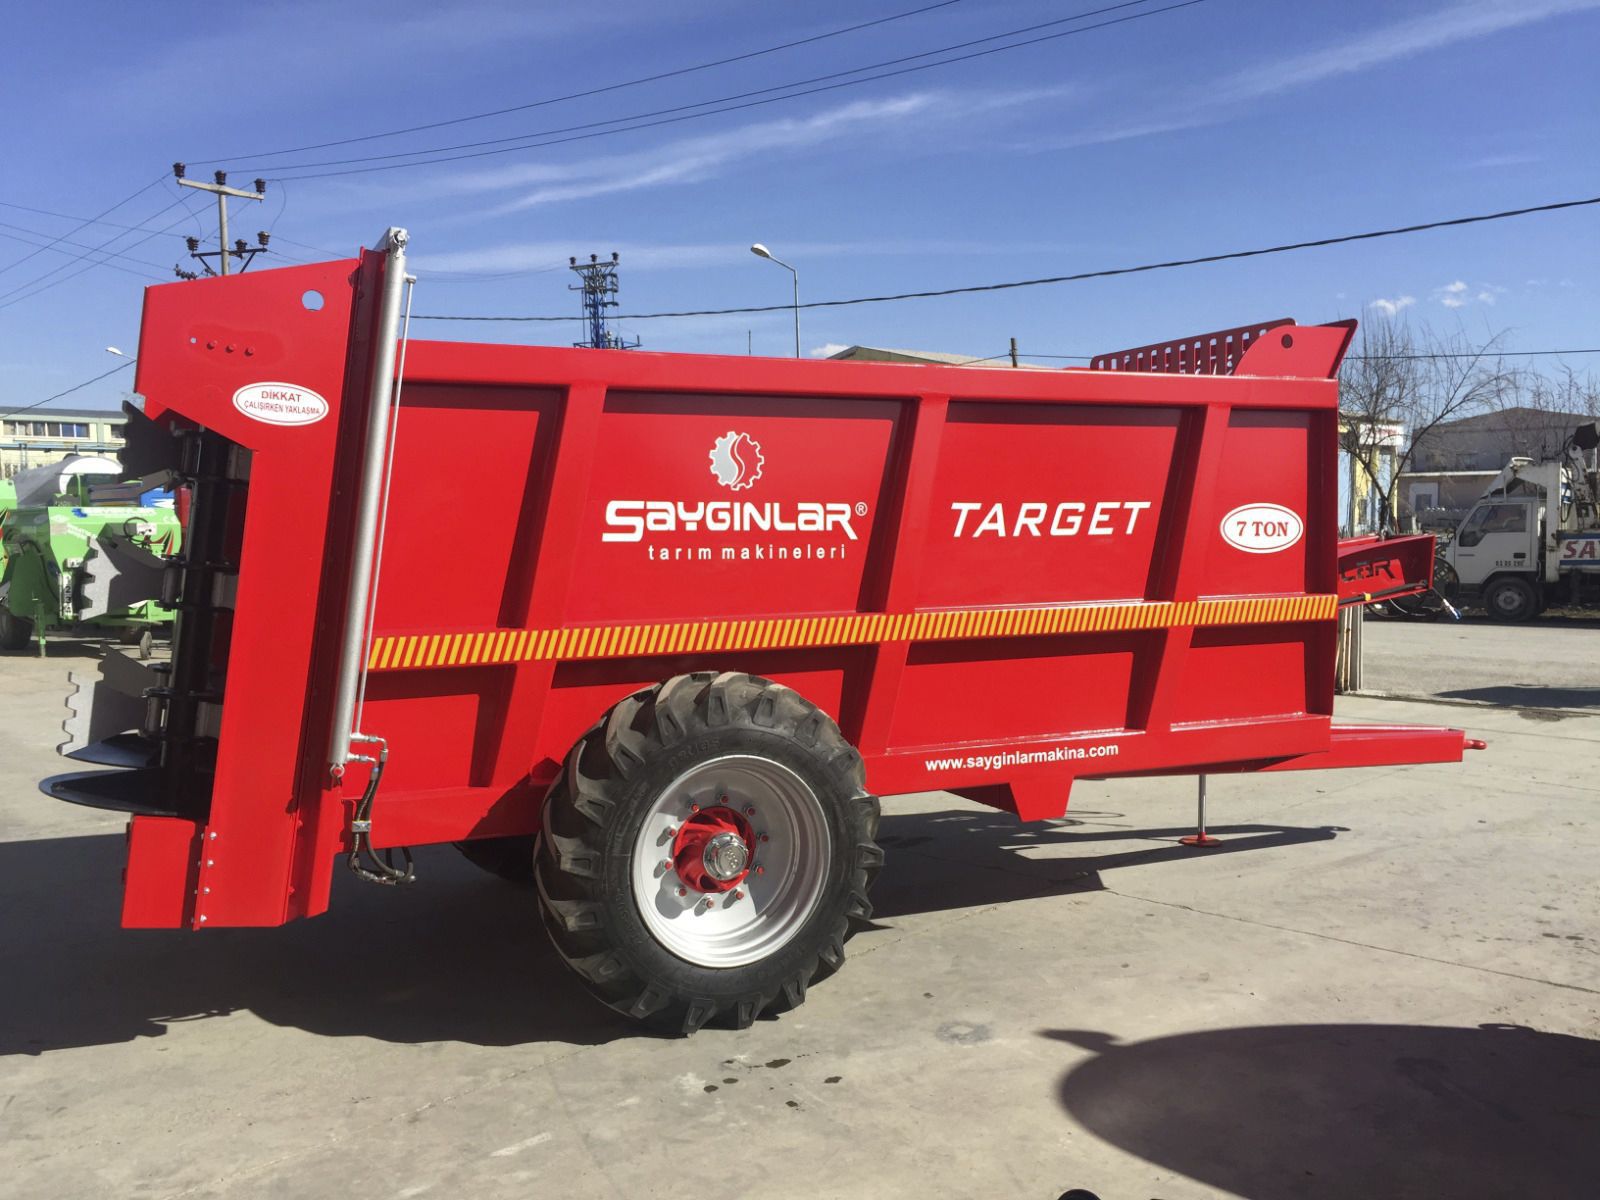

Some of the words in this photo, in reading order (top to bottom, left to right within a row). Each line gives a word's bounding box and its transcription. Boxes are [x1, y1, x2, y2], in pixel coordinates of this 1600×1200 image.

[261, 389, 302, 402] DİKKAT
[950, 501, 1151, 538] TARGET
[1236, 521, 1246, 537] 7
[1252, 521, 1289, 538] TON
[648, 545, 712, 561] tarım
[722, 544, 845, 561] makineleri
[1563, 541, 1600, 558] SA
[925, 744, 1119, 771] www.sayginlarmakina.com
